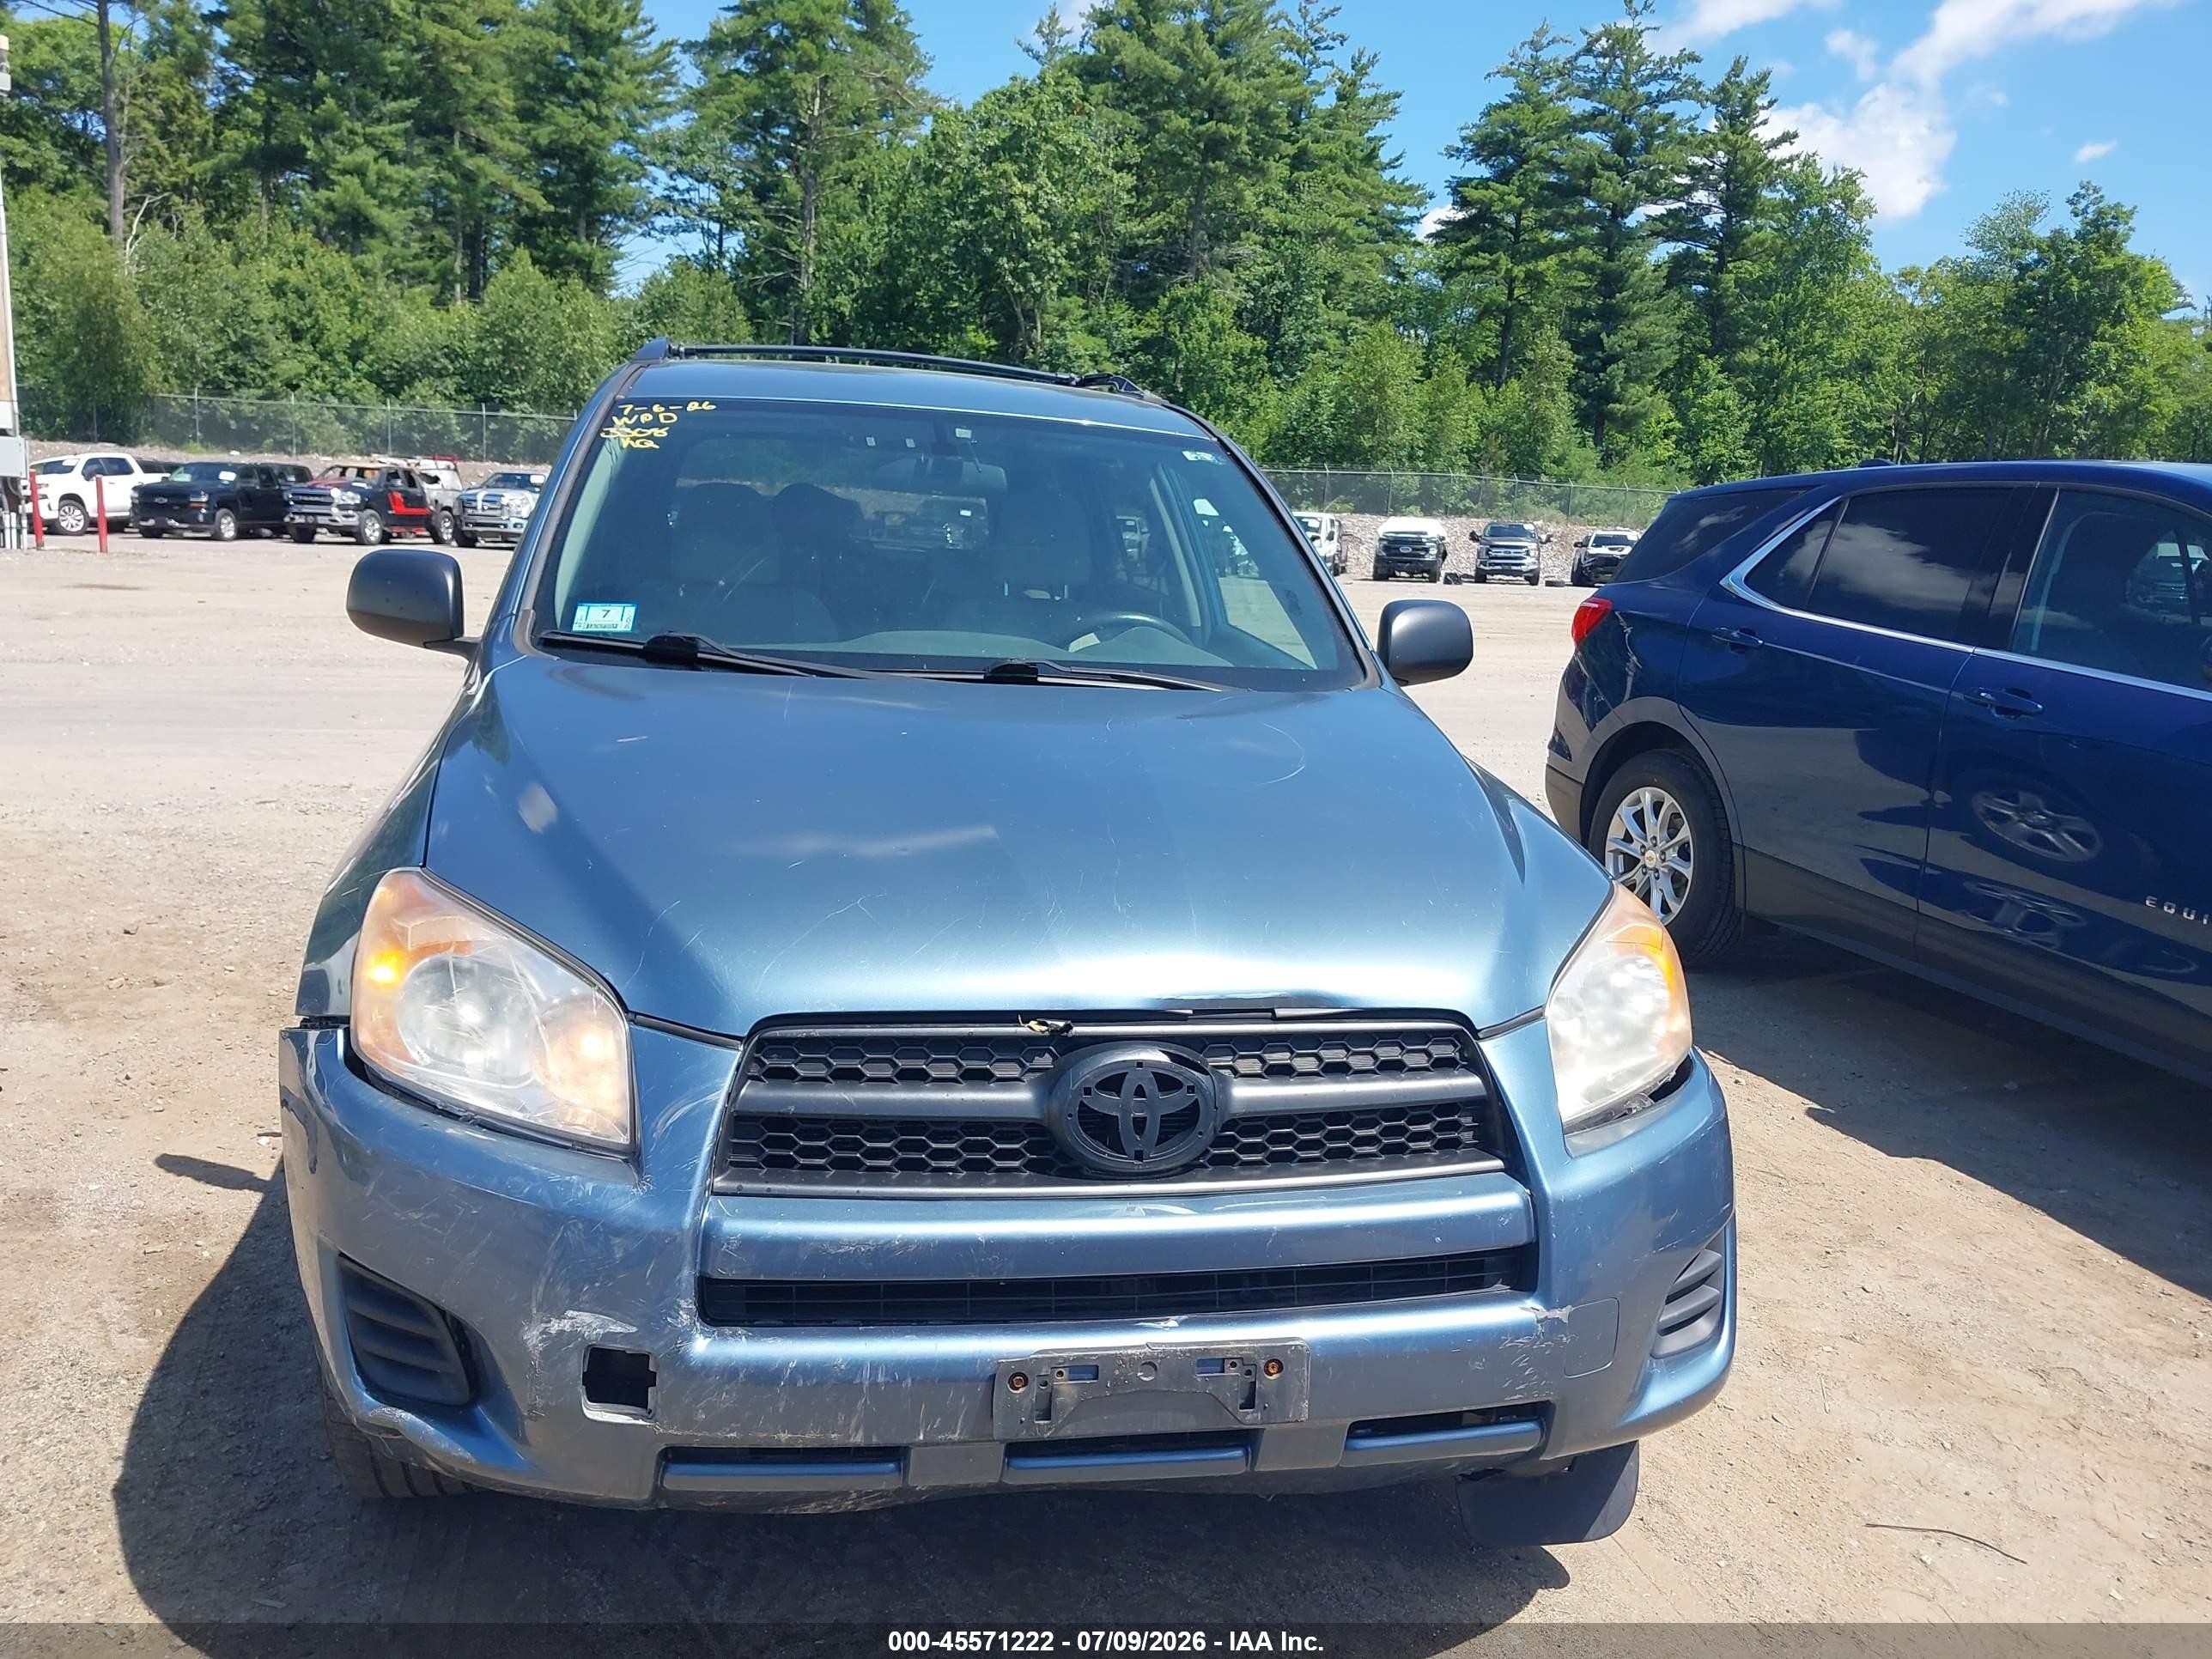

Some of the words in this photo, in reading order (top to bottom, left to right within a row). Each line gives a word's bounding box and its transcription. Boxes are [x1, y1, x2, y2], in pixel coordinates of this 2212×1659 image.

[611, 412, 678, 426] WPD
[602, 609, 611, 618] 7
[2145, 896, 2209, 925] EQUI
